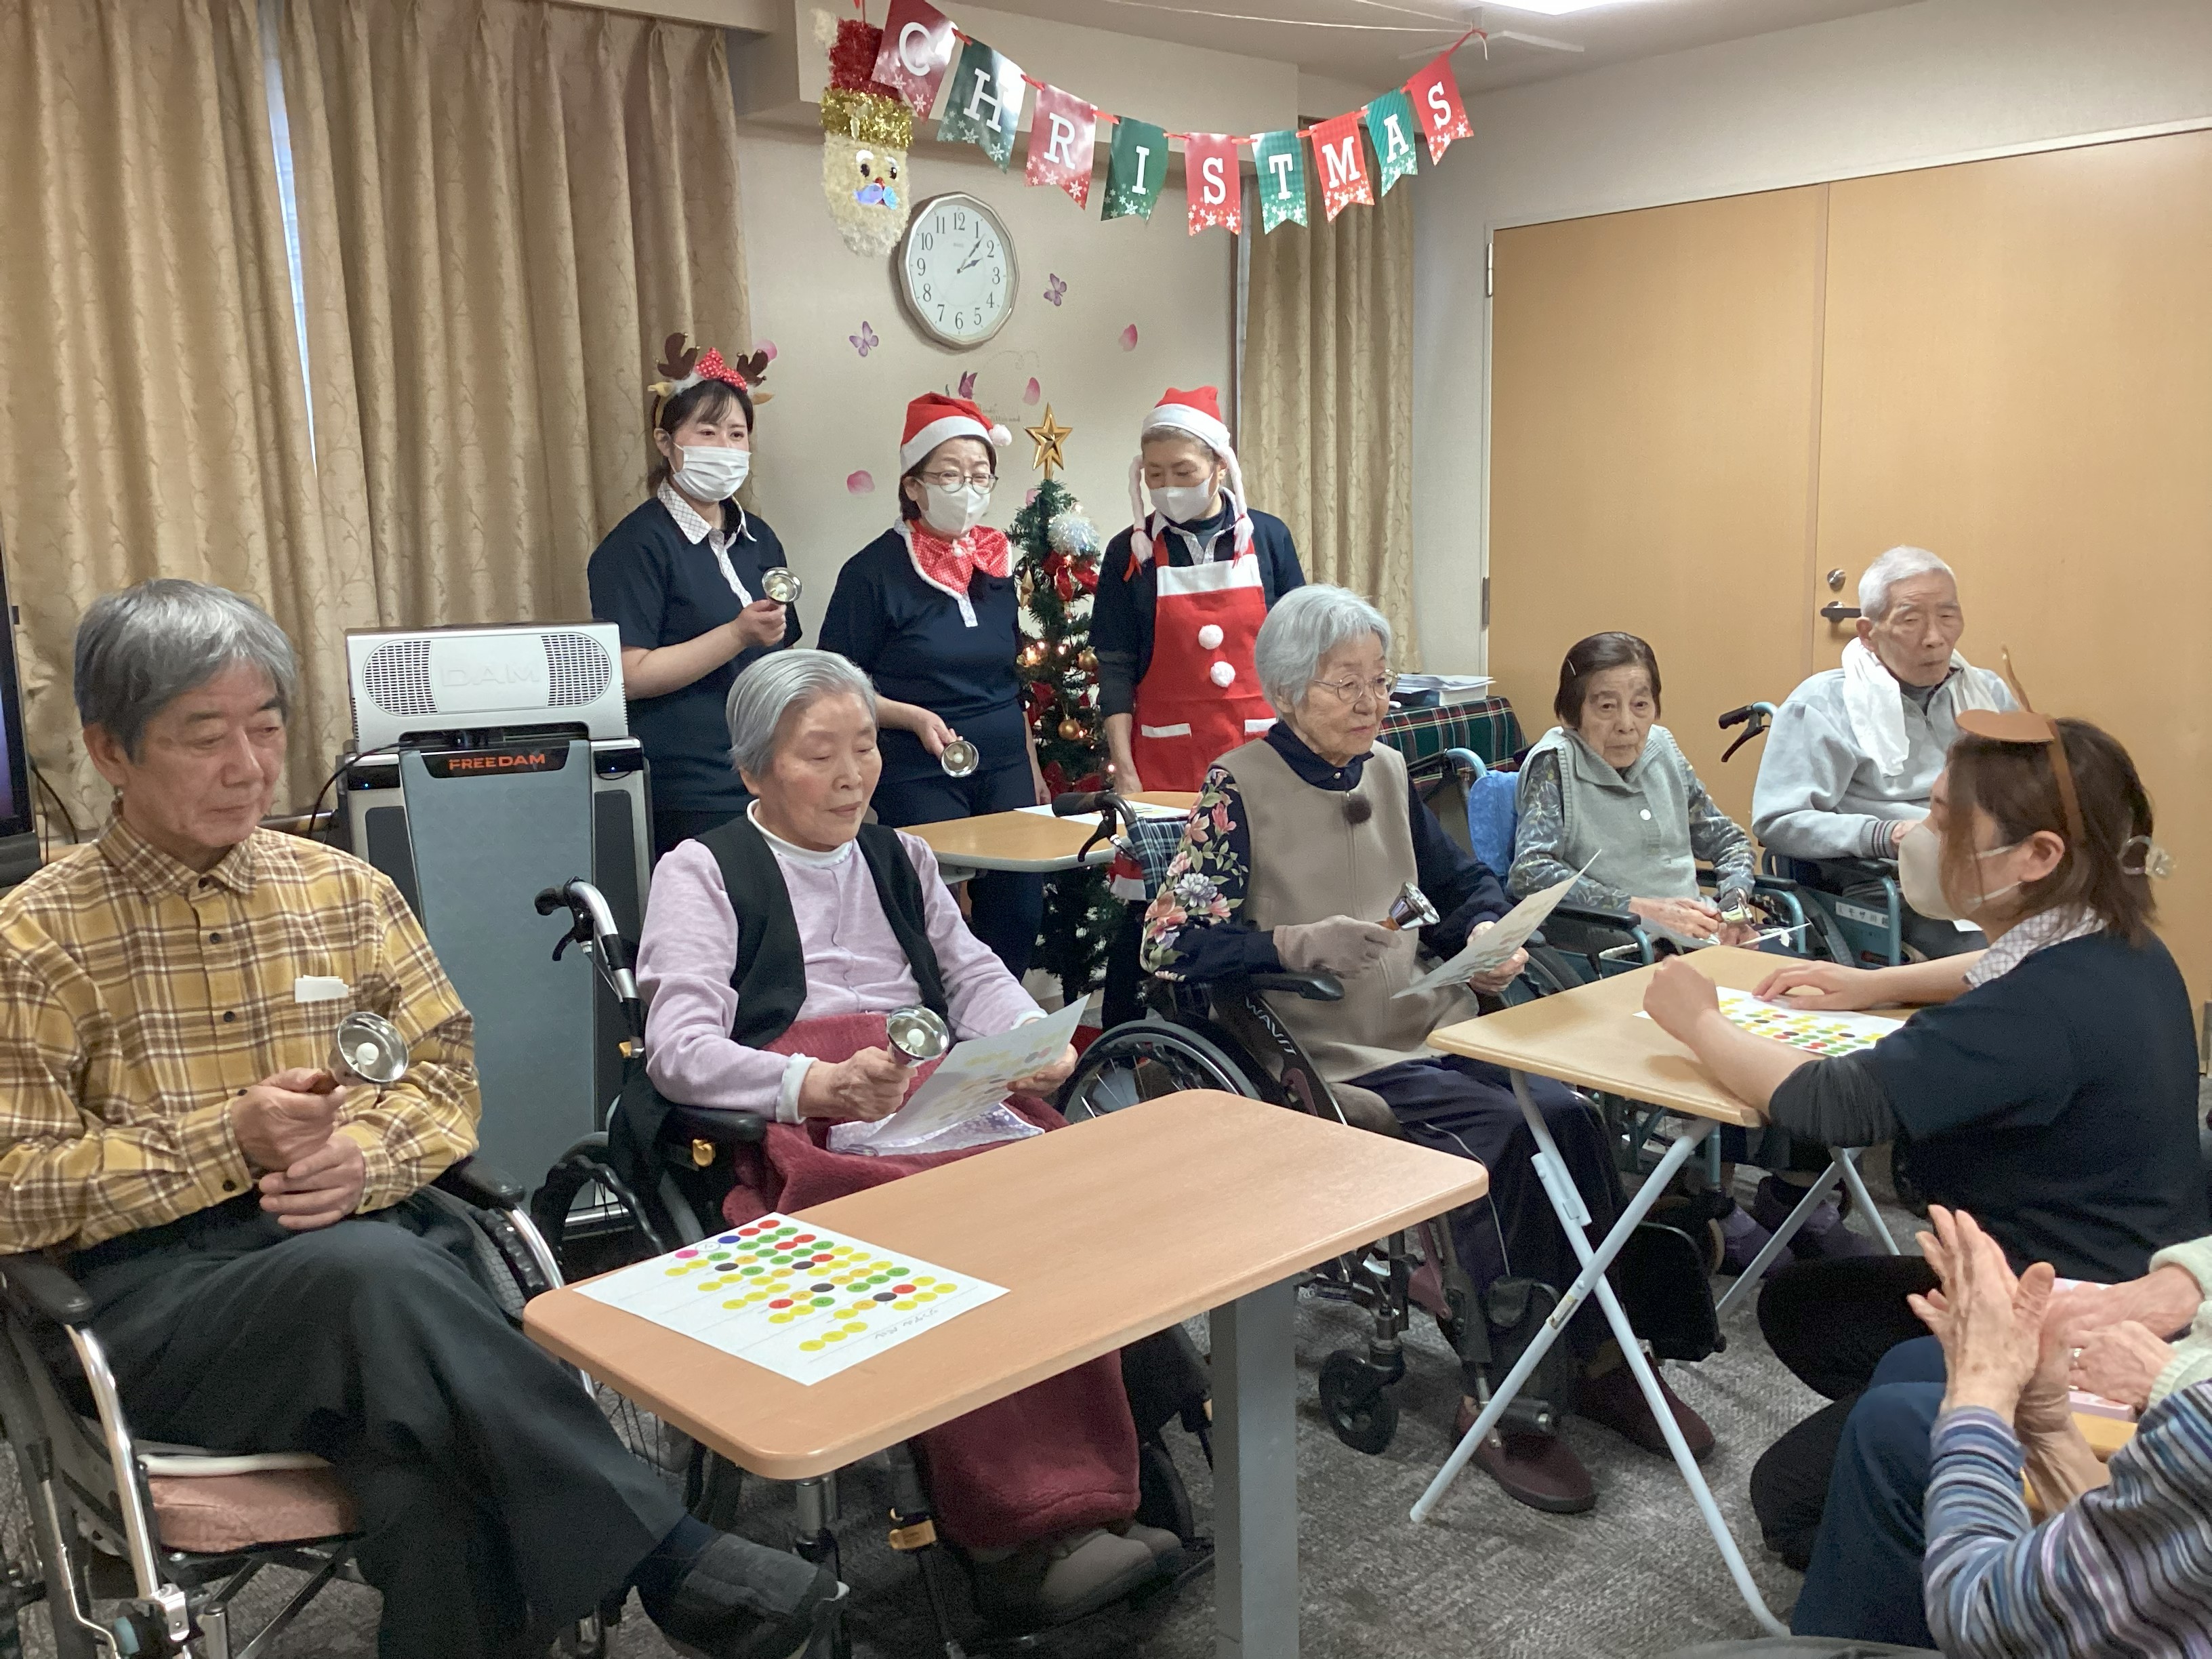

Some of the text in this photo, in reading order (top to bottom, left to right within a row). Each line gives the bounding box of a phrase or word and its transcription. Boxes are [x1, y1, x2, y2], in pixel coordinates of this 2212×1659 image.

[899, 22, 1452, 205] CHRISTMAS
[936, 216, 946, 234] 11
[954, 212, 966, 231] 12
[921, 232, 933, 251] 10
[987, 240, 994, 258] 2
[917, 258, 926, 276] 9
[992, 266, 1000, 285] 3
[922, 283, 931, 302] 8
[986, 291, 994, 308] 4
[937, 304, 945, 322] 7
[955, 312, 963, 329] 6
[973, 307, 981, 325] 5
[442, 663, 540, 687] DAM
[449, 753, 546, 771] FREEDAM
